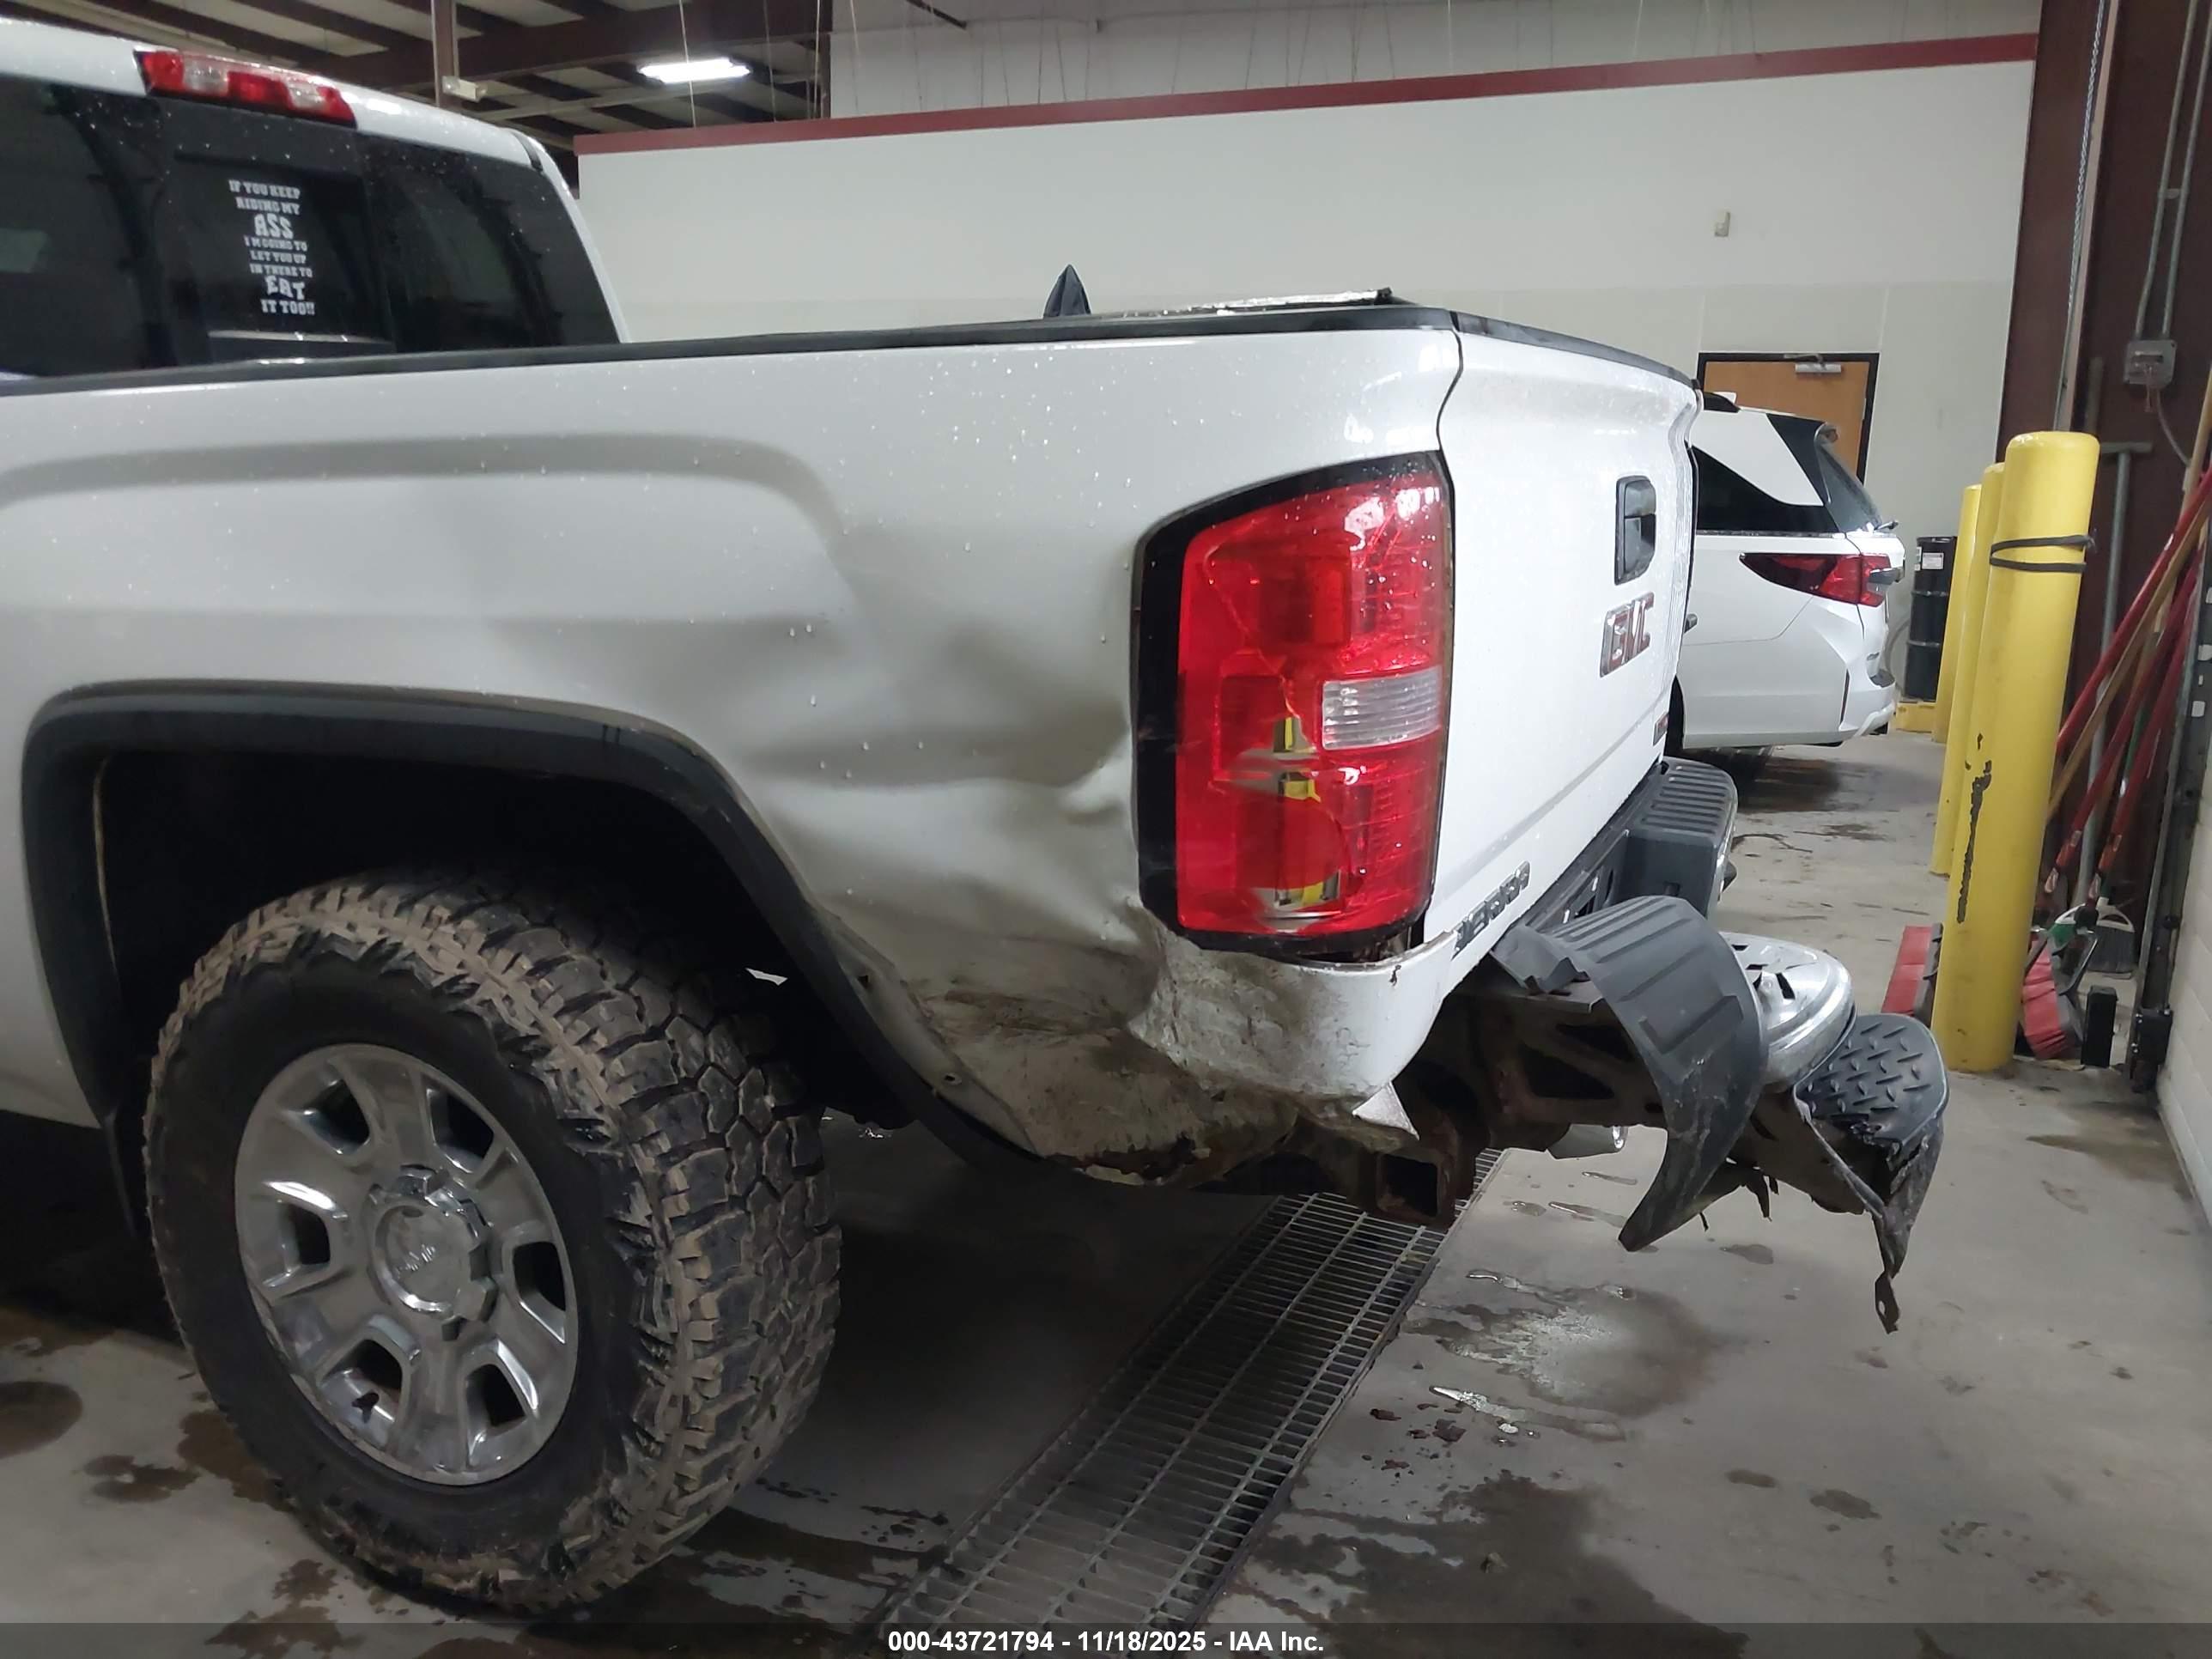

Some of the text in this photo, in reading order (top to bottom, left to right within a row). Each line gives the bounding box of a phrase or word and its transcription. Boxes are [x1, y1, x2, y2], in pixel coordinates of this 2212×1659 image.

[228, 179, 301, 199] IF YOU KEEP
[235, 197, 301, 216] RIDING MY
[254, 213, 294, 240] ASS
[262, 237, 292, 250] GOING
[294, 240, 307, 252] TO
[250, 250, 307, 264] LET YOU UP
[249, 263, 313, 277] IN THERE TO
[264, 276, 305, 301] EAT
[260, 299, 276, 313] IT
[1600, 592, 1654, 678] GMC
